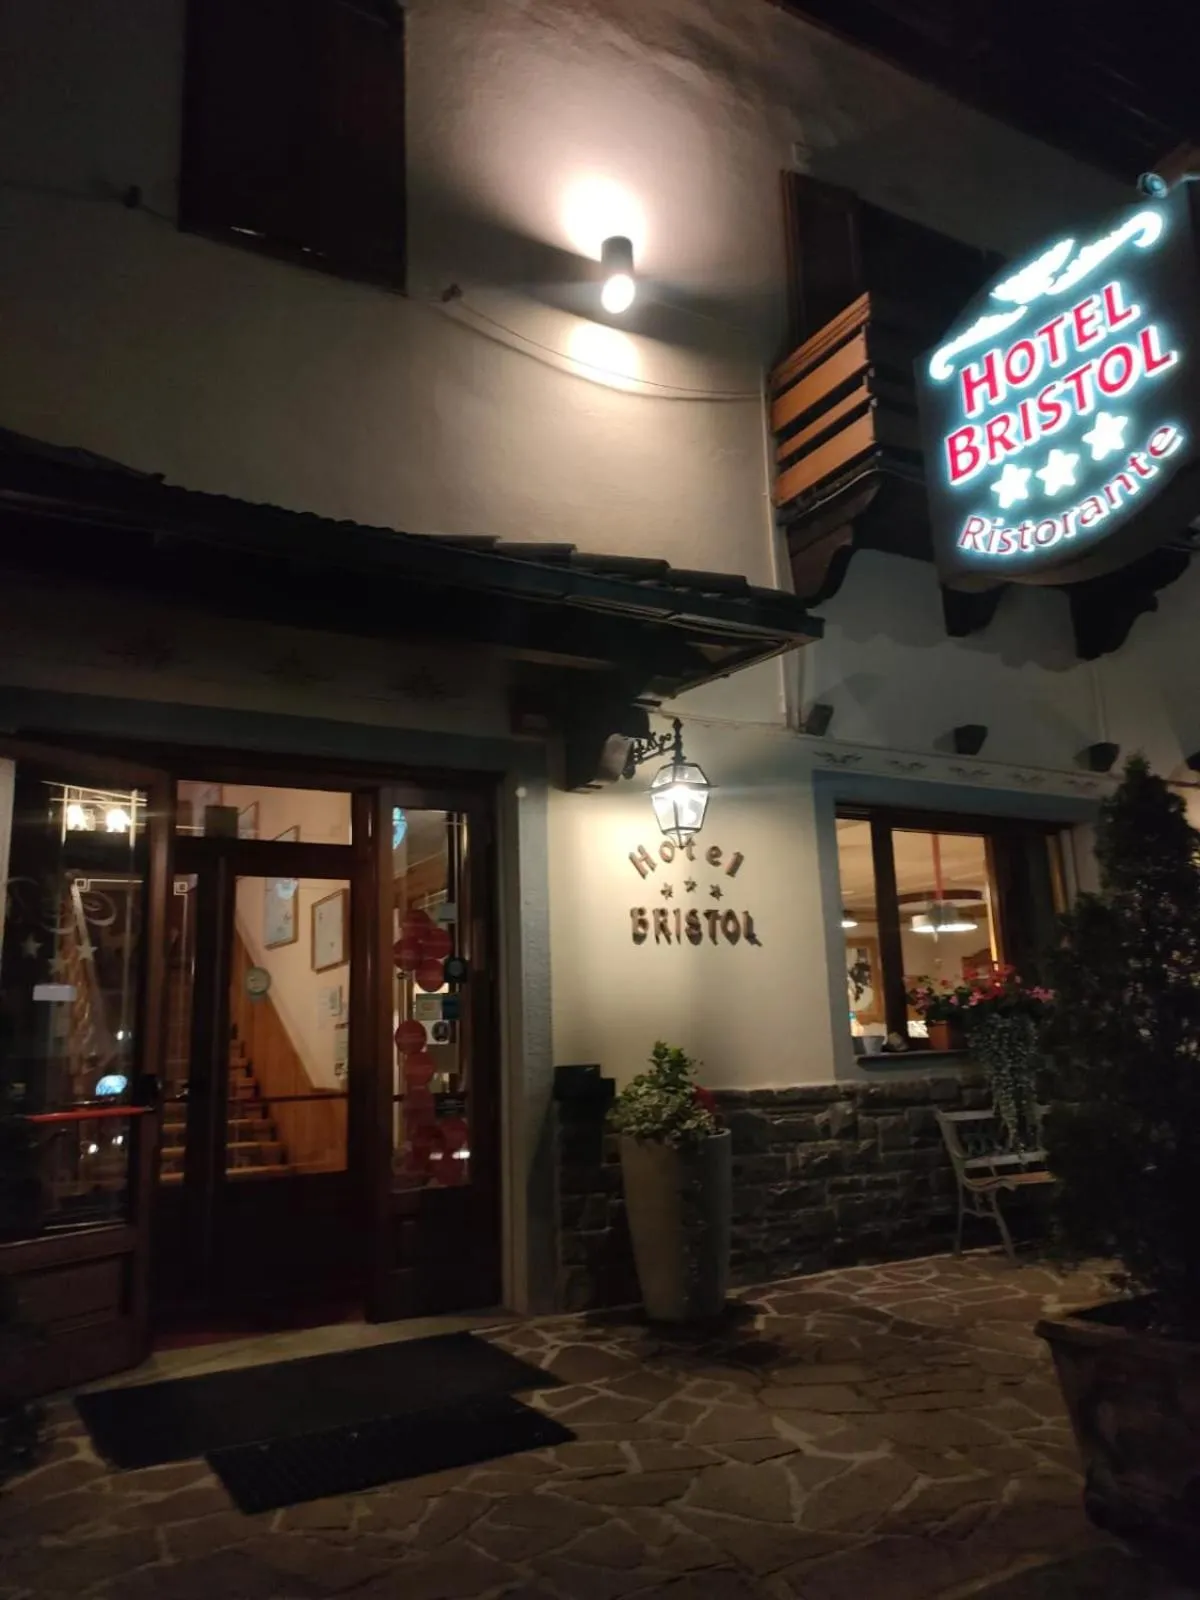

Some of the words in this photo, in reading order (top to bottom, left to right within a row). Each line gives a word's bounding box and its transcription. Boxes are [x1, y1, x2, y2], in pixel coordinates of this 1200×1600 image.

[945, 327, 1177, 484] BRISTOL
[959, 282, 1139, 418] HOTEL
[958, 424, 1184, 554] Ristorante
[628, 835, 745, 879] Hotel
[629, 907, 763, 947] BRISTOL
